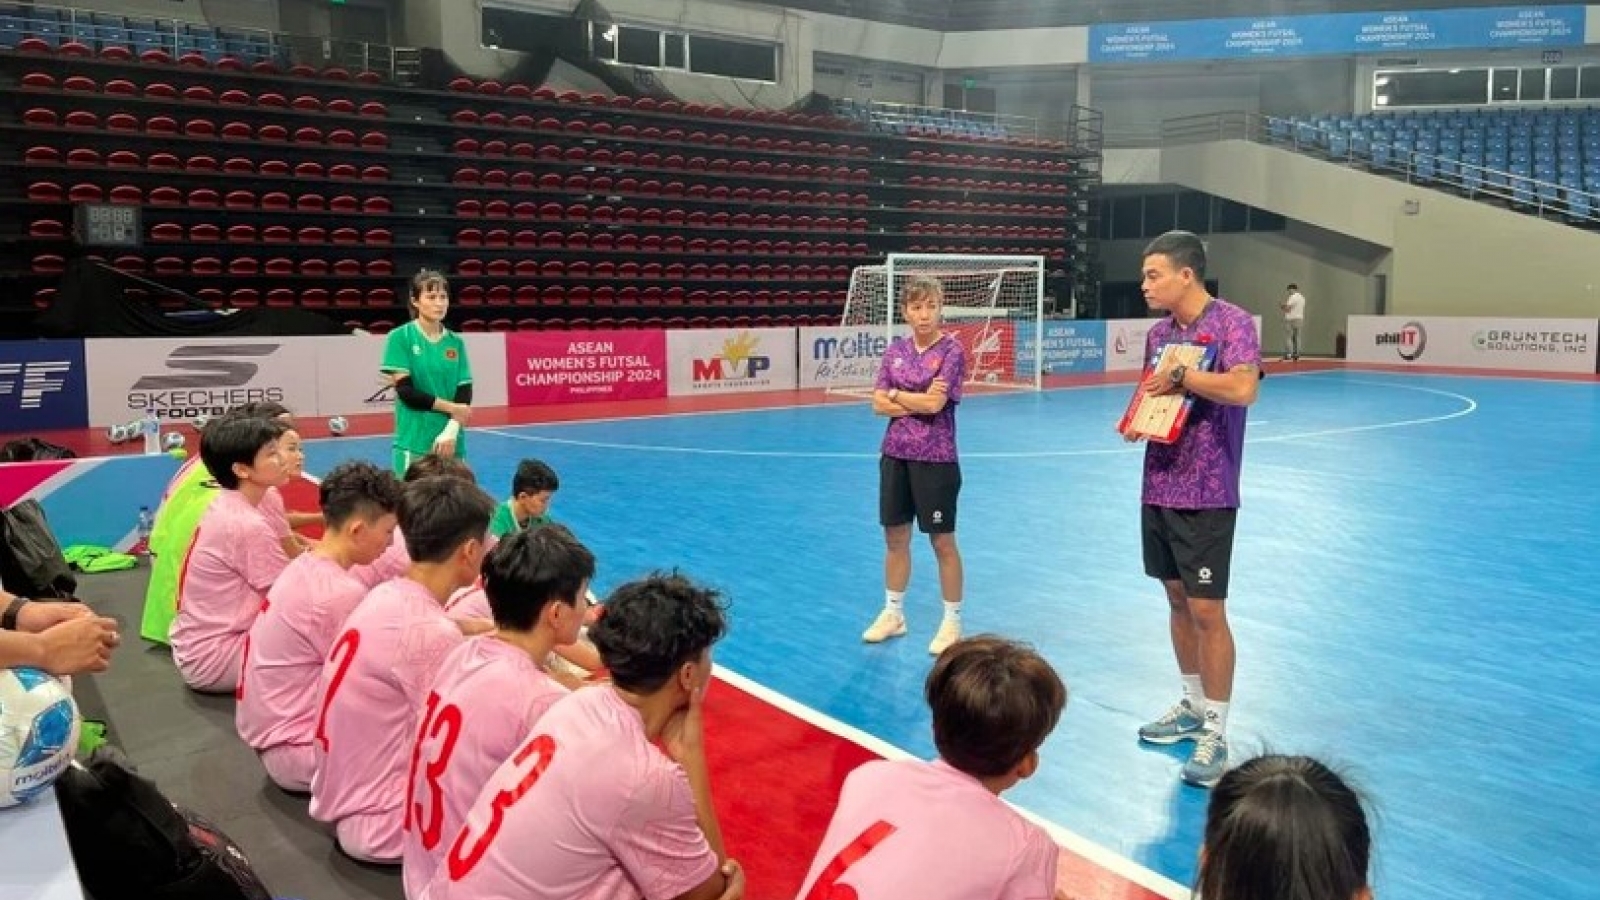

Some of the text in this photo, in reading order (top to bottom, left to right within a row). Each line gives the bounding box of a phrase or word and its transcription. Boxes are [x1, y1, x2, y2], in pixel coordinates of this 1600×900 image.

[1487, 330, 1587, 343] GRUNTECH
[567, 341, 613, 355] ASEAN
[1564, 345, 1587, 353] INC
[527, 355, 650, 370] WOMEN'S FUTSAL
[693, 356, 770, 381] MVP
[516, 369, 661, 386] CHAMPIONSHIP 2024
[127, 387, 284, 410] SKECHERS
[403, 690, 463, 851] 13
[448, 734, 556, 882] 3
